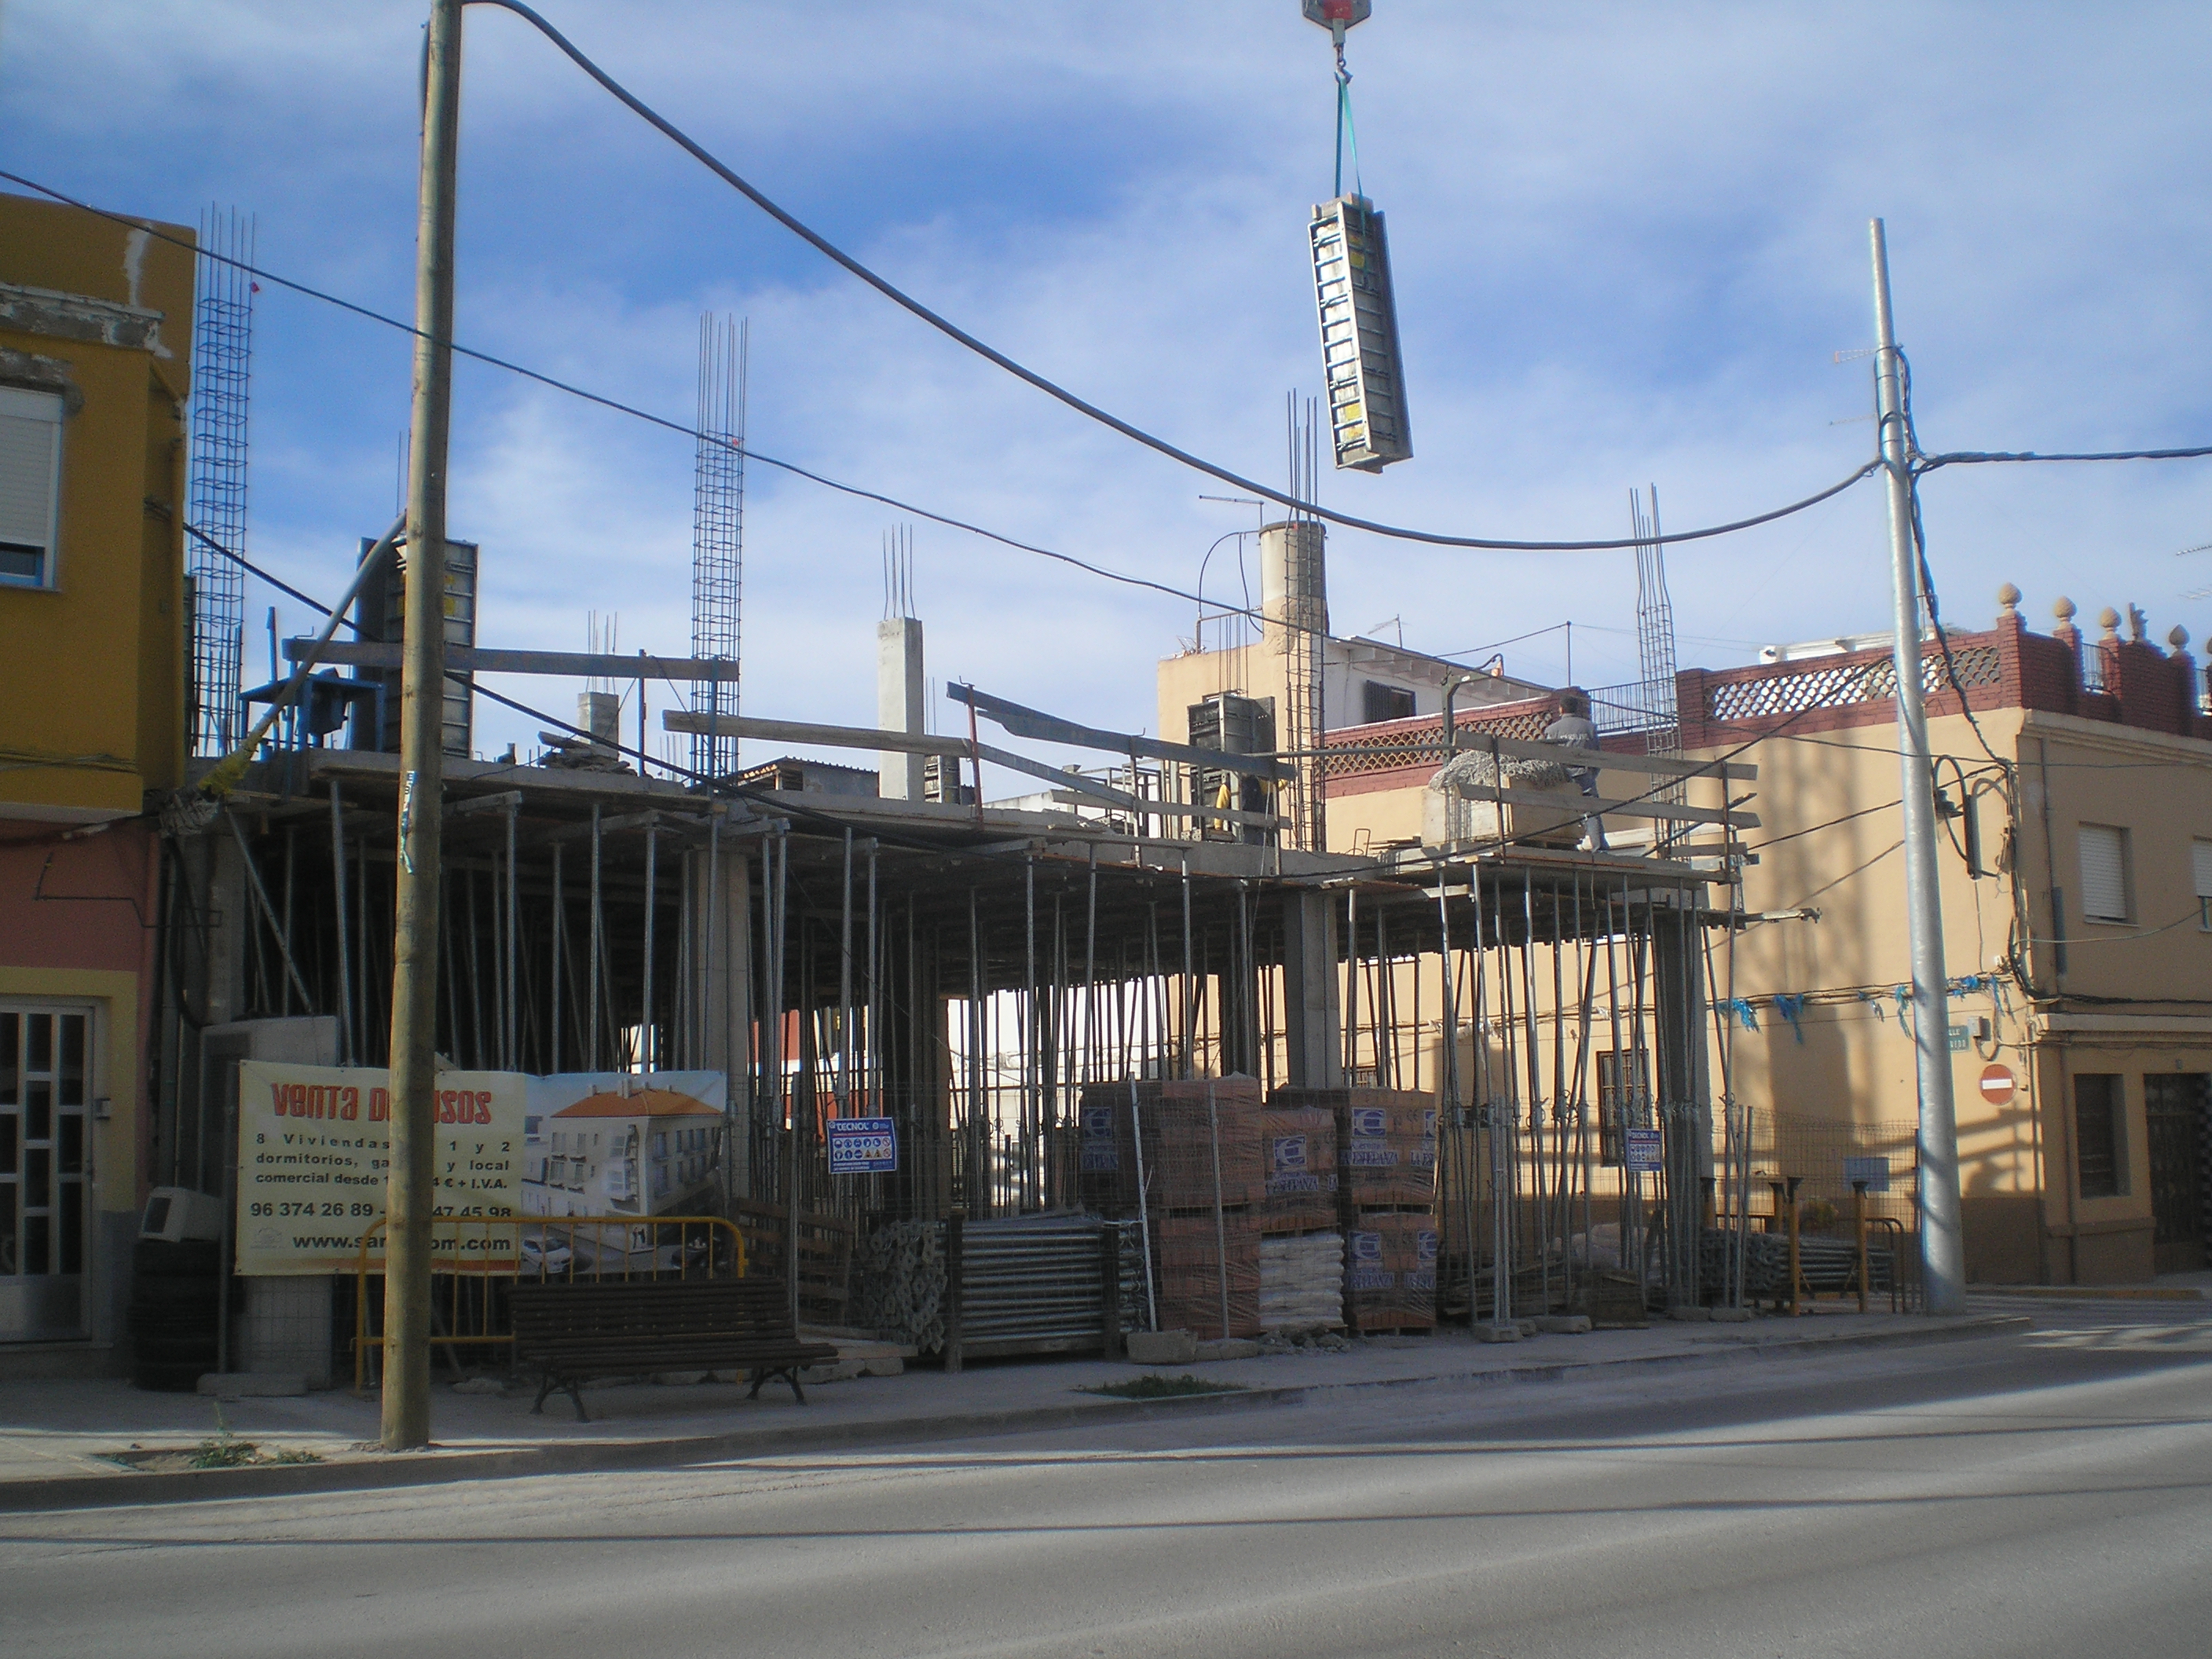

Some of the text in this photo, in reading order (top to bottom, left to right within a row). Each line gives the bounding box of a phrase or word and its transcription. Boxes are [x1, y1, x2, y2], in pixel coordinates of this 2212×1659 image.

[368, 1087, 390, 1122] D
[434, 1090, 492, 1125] ISOS
[256, 1133, 510, 1154] 8 Viviendas 1 y 2
[256, 1153, 509, 1173] dormitorios, y local
[255, 1173, 329, 1184] comercial
[334, 1174, 379, 1185] desde
[471, 1178, 507, 1188] I.V.A.
[250, 1203, 273, 1217] 96
[280, 1203, 315, 1217] 374
[321, 1203, 344, 1217] 26
[350, 1203, 373, 1217] 89
[433, 1206, 454, 1217] 47
[460, 1206, 482, 1217] 45
[489, 1207, 511, 1217] 98
